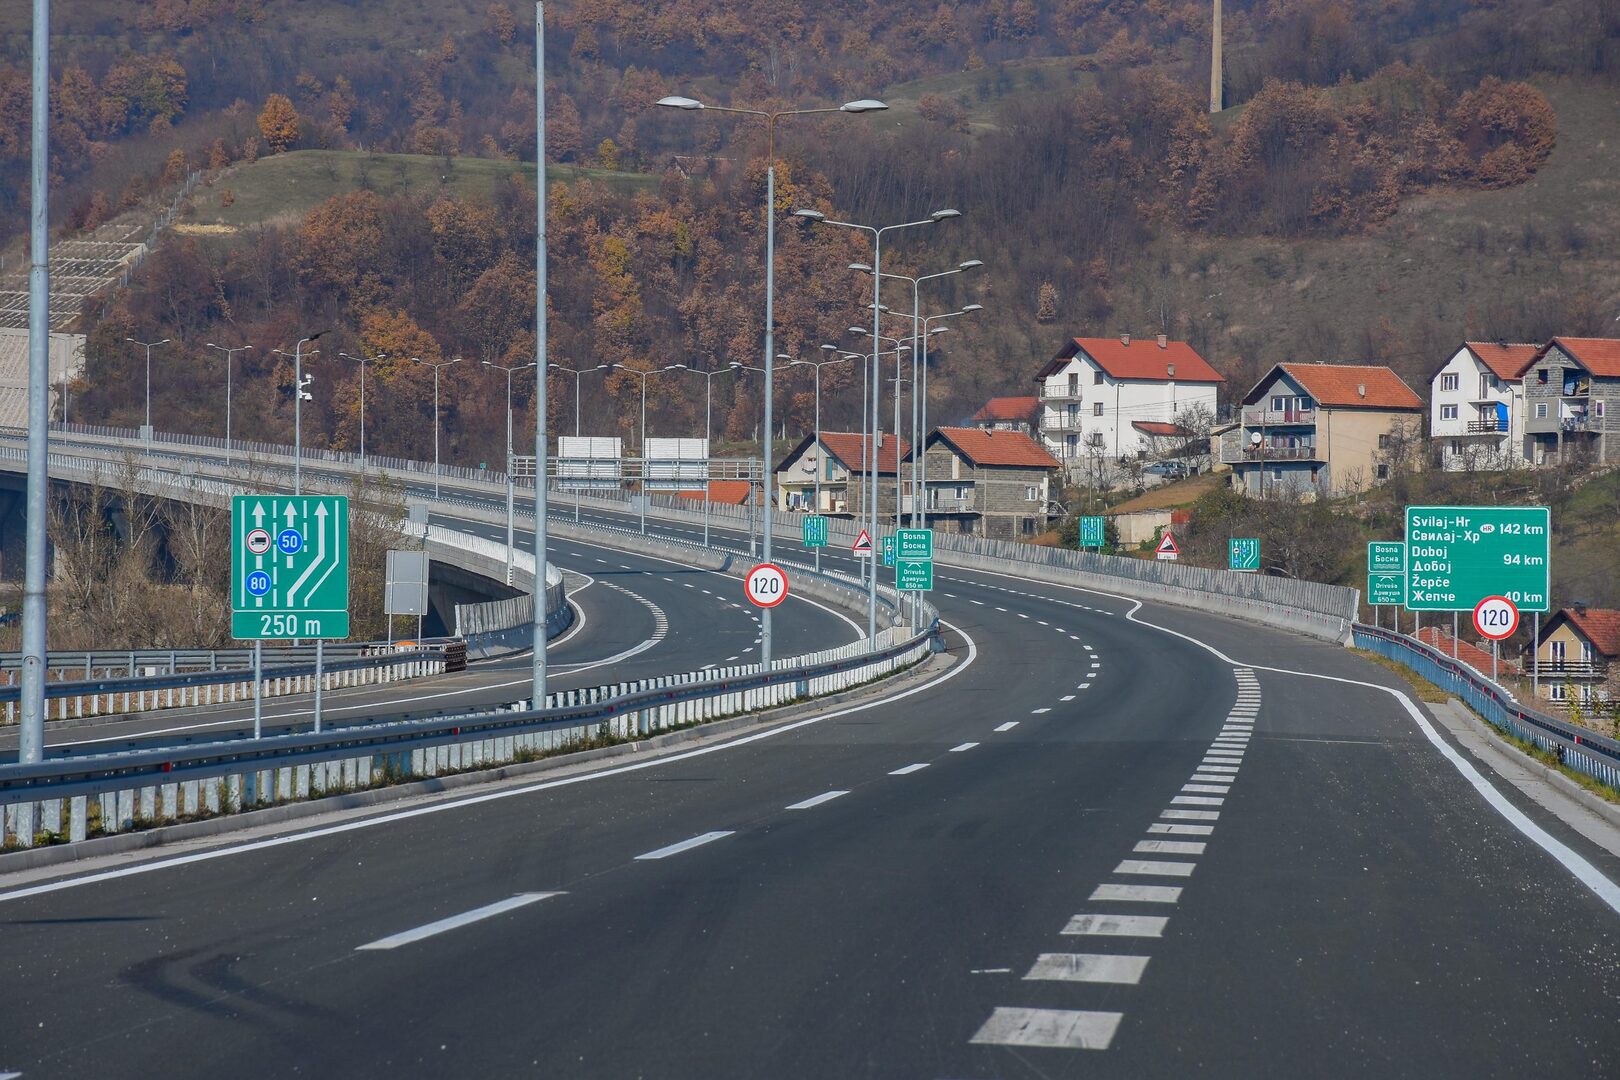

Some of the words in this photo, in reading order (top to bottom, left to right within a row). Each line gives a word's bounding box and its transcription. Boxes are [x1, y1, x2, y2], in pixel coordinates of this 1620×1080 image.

[1412, 516, 1470, 529] Svilaj-Hr
[1499, 524, 1521, 534] 142
[1523, 523, 1543, 535] km
[282, 535, 298, 548] 50
[902, 532, 926, 540] Bosna
[1412, 530, 1480, 544] Свилај-Хр
[902, 541, 926, 549] Босна
[1375, 545, 1399, 553] Bosna
[1375, 554, 1399, 562] Босна
[1411, 546, 1448, 559] Doboj
[1503, 554, 1521, 565] 94
[1524, 555, 1543, 565] km
[1411, 561, 1452, 574] Добој
[250, 577, 267, 590] 80
[753, 577, 779, 594] 120
[1411, 573, 1450, 589] Žepče
[1412, 590, 1456, 602] Жепче
[1504, 591, 1521, 602] 40
[1524, 591, 1543, 602] km
[1482, 609, 1509, 626] 120
[260, 614, 298, 636] 250
[305, 619, 321, 635] m
